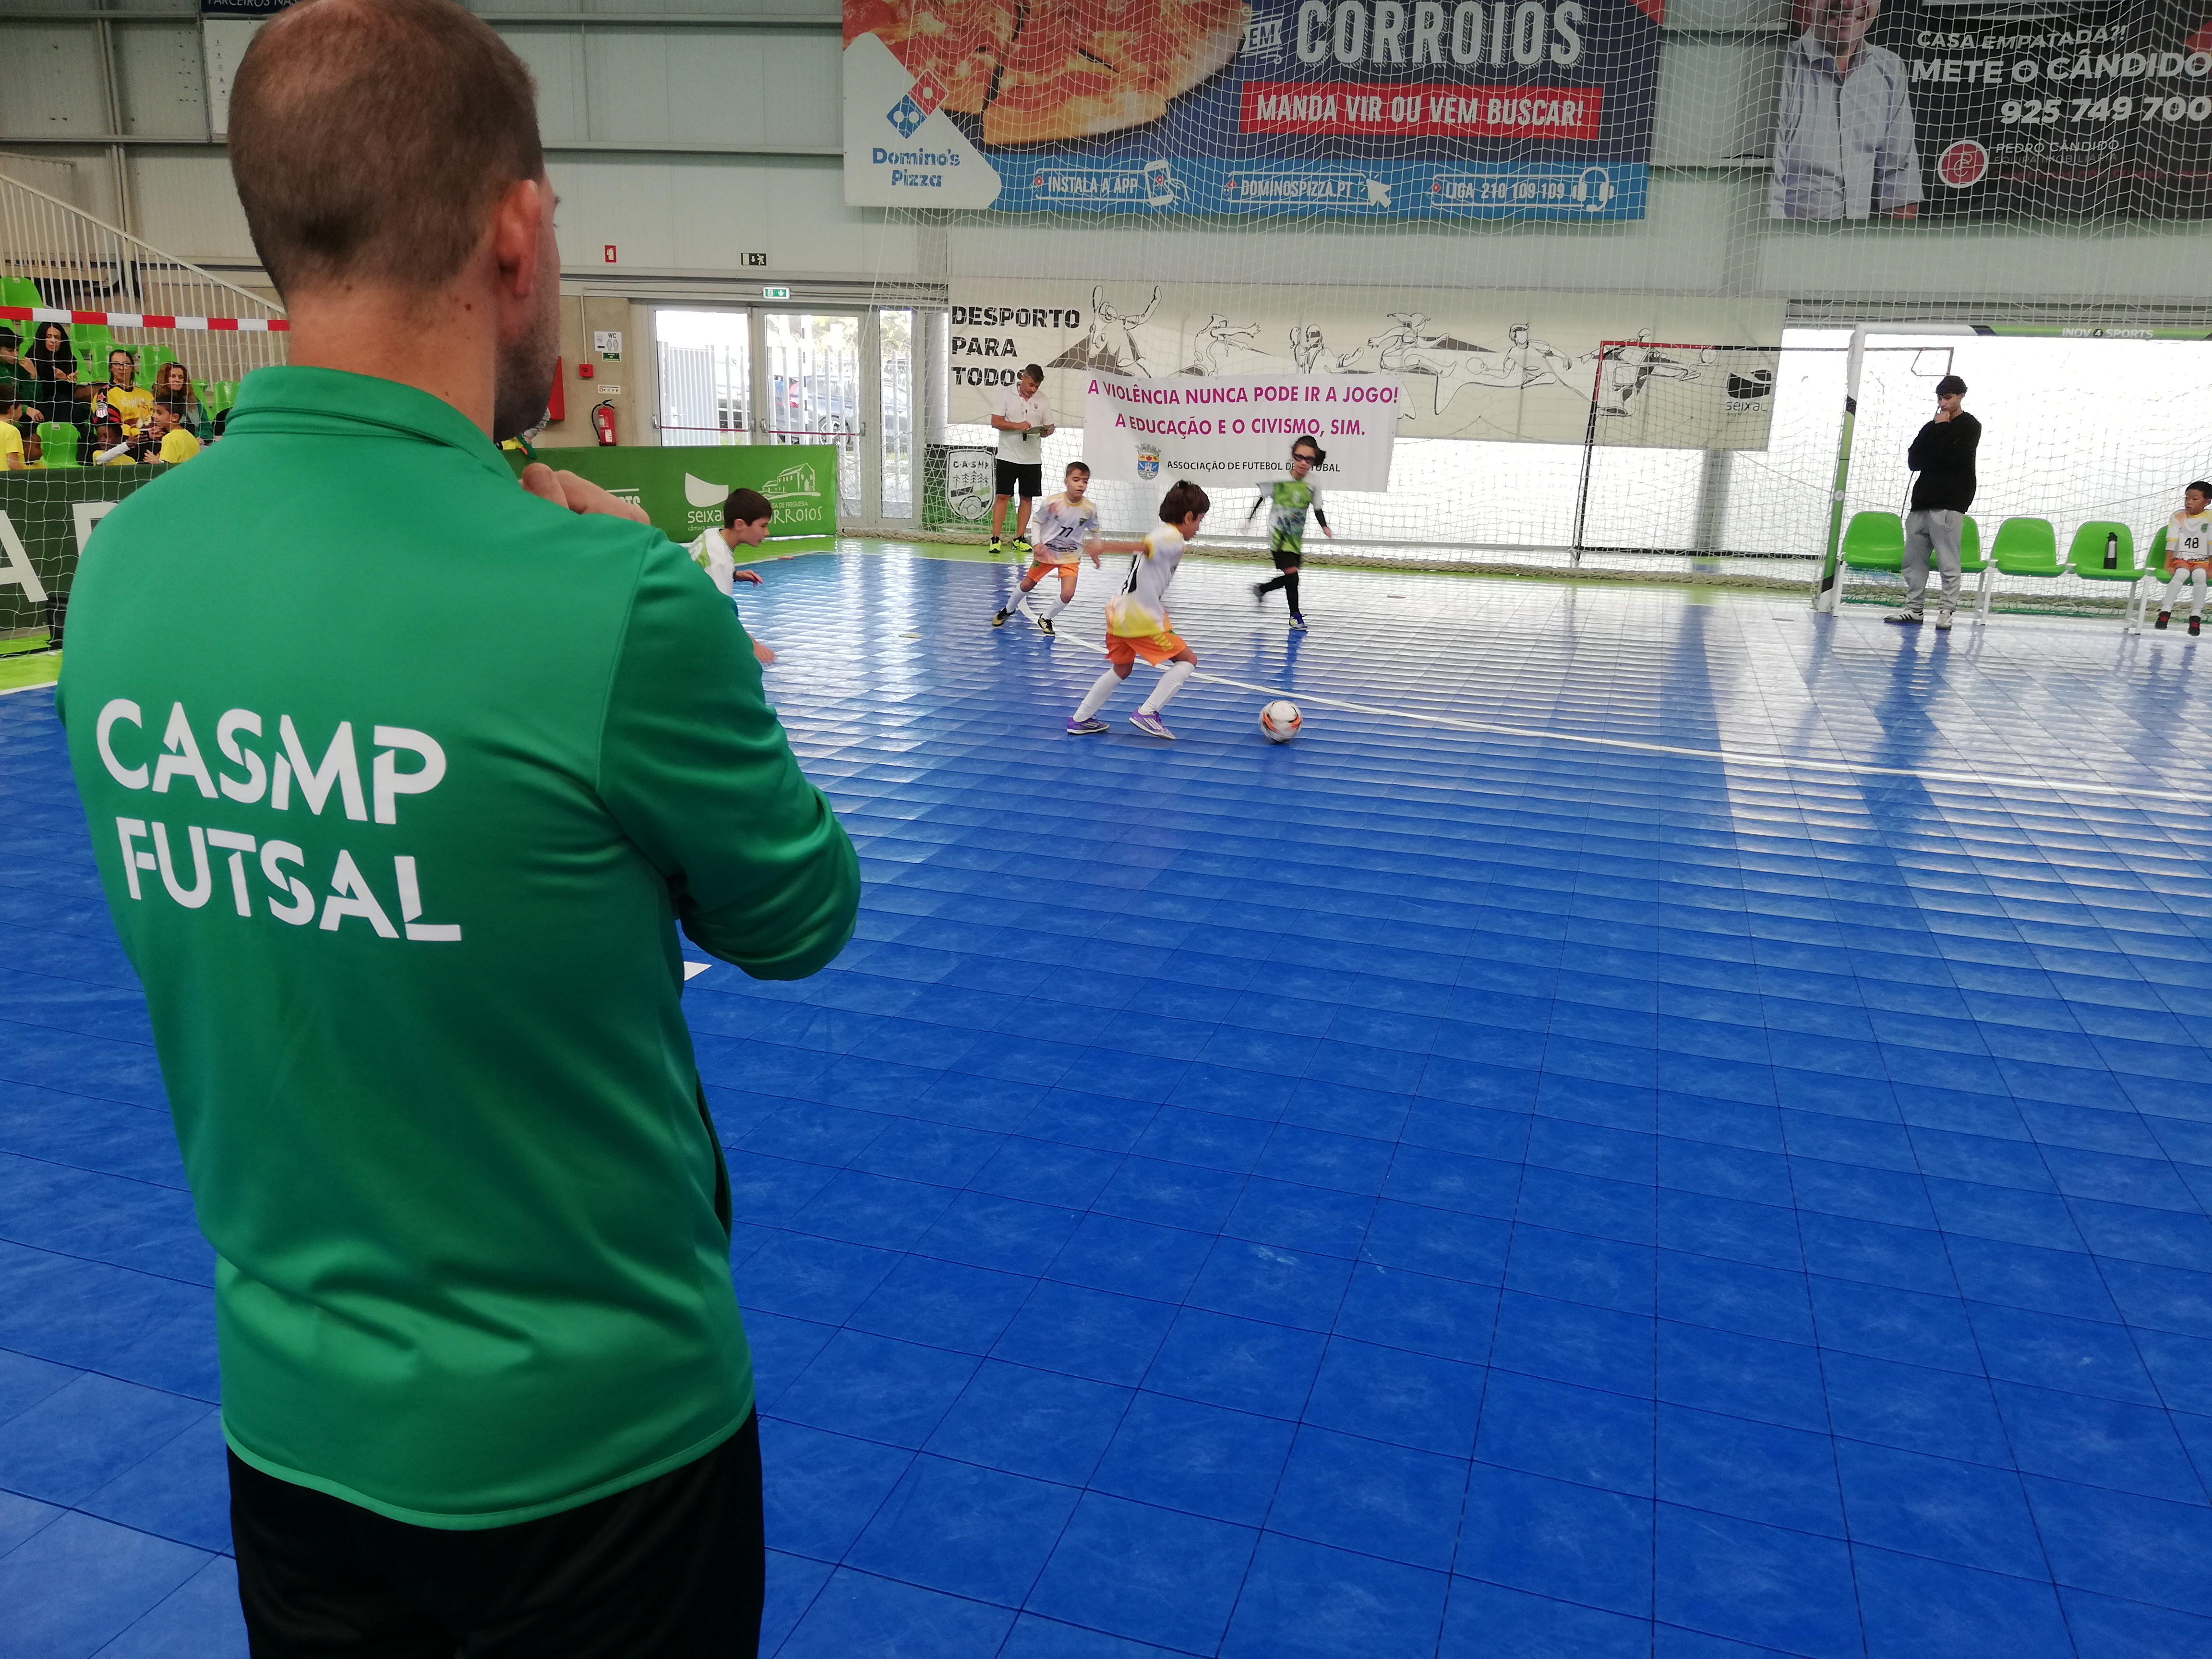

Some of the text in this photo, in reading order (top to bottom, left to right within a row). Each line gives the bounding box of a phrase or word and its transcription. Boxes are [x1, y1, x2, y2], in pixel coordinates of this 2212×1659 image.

[1297, 1, 1586, 66] CORROIOS
[1917, 31, 1975, 48] CASA
[1911, 48, 2210, 83] METE O CÂNDIDO
[1257, 95, 1584, 126] MANDA VIR OU VEM BUSCAR!
[2000, 96, 2212, 124] 925 749 700
[1996, 139, 2120, 154] PEDRO CÂNDIDO
[873, 147, 961, 167] Domino's
[891, 168, 942, 187] Pizza
[1048, 176, 1138, 193] INSTALA A APP
[1241, 180, 1353, 197] DOMINOSPIZZA.PT
[1445, 182, 1565, 199] LIGA 210 109 109
[951, 306, 1080, 329] DESPORTO
[2104, 329, 2154, 338] SPORTS
[951, 337, 1018, 357] PARA
[1087, 379, 1398, 404] A VIOLÊNCIA NUNCA PODE IR A JOGO!
[1115, 413, 1365, 439] A EDUCAÇÃO E O CIVISMO, SIM.
[1167, 460, 1225, 472] ASSOCIAÇÃO
[1227, 462, 1240, 470] DE
[1242, 462, 1283, 470] FUTEBOL
[768, 506, 822, 524] RROIOS
[2184, 537, 2199, 549] 48
[96, 698, 446, 825] CASMP
[115, 817, 462, 941] FUTSAL
